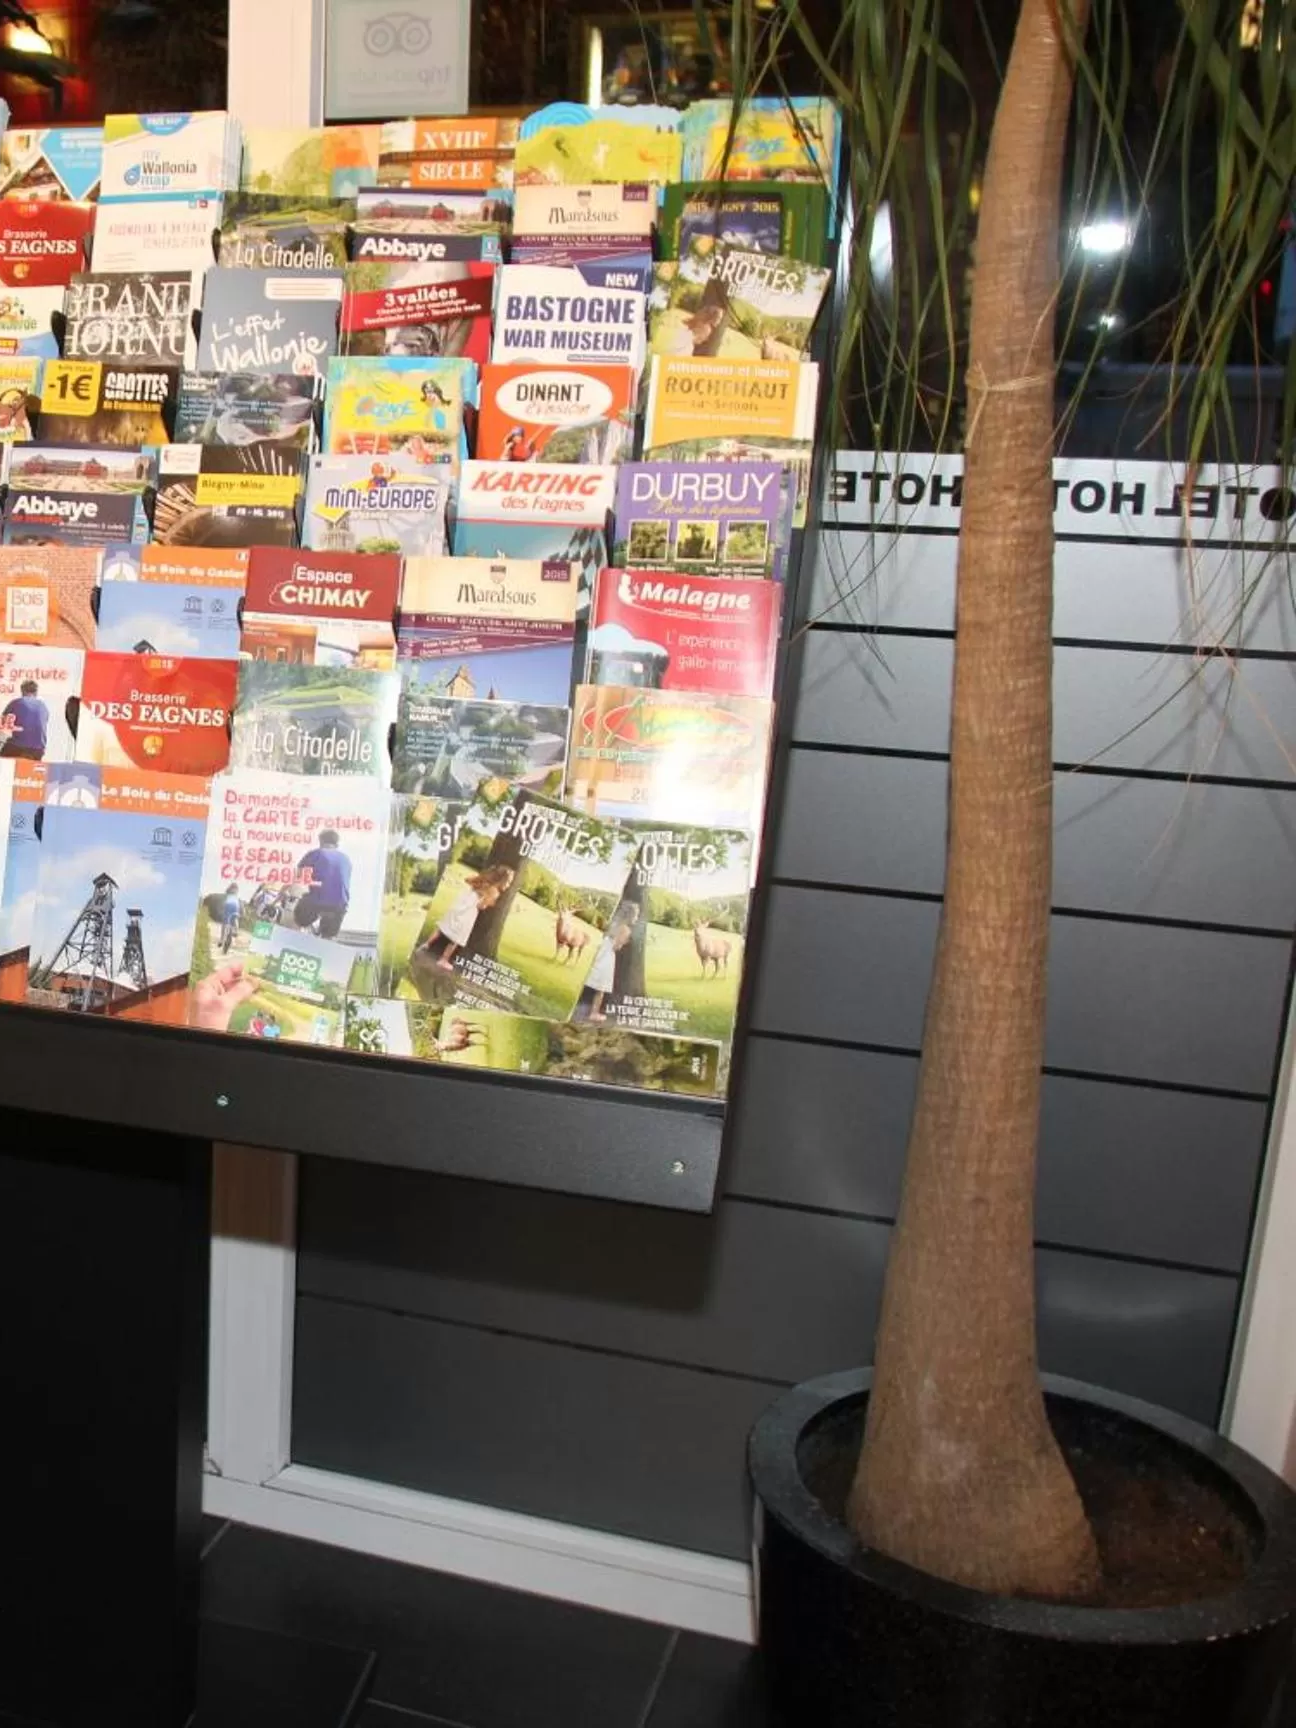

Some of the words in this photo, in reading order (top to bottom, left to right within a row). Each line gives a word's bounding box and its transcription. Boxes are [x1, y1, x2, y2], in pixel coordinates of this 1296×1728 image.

[142, 160, 197, 175] Wallonia
[140, 175, 171, 189] map
[3, 227, 49, 240] Brasserie
[10, 238, 78, 256] FAGNES
[235, 243, 257, 265] La
[263, 241, 335, 269] Citadelle
[359, 236, 447, 262] Abbaye
[604, 272, 639, 288] NEW
[707, 254, 799, 295] GROTTES
[384, 292, 397, 307] 3
[397, 286, 458, 305] vallées
[505, 296, 636, 325] BASTOGNE
[212, 307, 287, 343] L'effet
[210, 331, 328, 373] Wallonie
[503, 329, 546, 351] WAR
[550, 329, 633, 353] MUSEUM
[103, 371, 169, 402] GROTTES
[516, 382, 585, 402] DINANT
[664, 374, 790, 400] ROCHEHAUT
[471, 470, 603, 497] KARTING
[631, 471, 776, 502] DURBUY
[12, 494, 98, 522] Abbaye
[501, 493, 527, 510] des
[531, 495, 585, 514] Fagnes
[294, 565, 354, 586] Espace
[543, 568, 569, 581] 2015
[278, 582, 373, 608] CHIMAY
[456, 582, 538, 606] Maredsous
[640, 580, 752, 612] Malagne
[8, 666, 69, 684] gratuite
[129, 688, 186, 704] Brasserie
[89, 700, 135, 720] DES
[138, 705, 225, 728] FAGNES
[251, 729, 275, 753] La
[282, 725, 373, 762] Citadelle
[126, 785, 151, 800] Bois
[223, 789, 312, 808] Demandez
[222, 808, 238, 824] la
[241, 807, 301, 827] CARTE
[303, 812, 375, 832] gratuite
[221, 825, 241, 840] du
[245, 829, 313, 845] nouveau
[499, 804, 605, 865] GROTTES
[220, 841, 293, 864] RÉSEAU
[635, 842, 717, 876] OTTES
[282, 952, 318, 971] 1000
